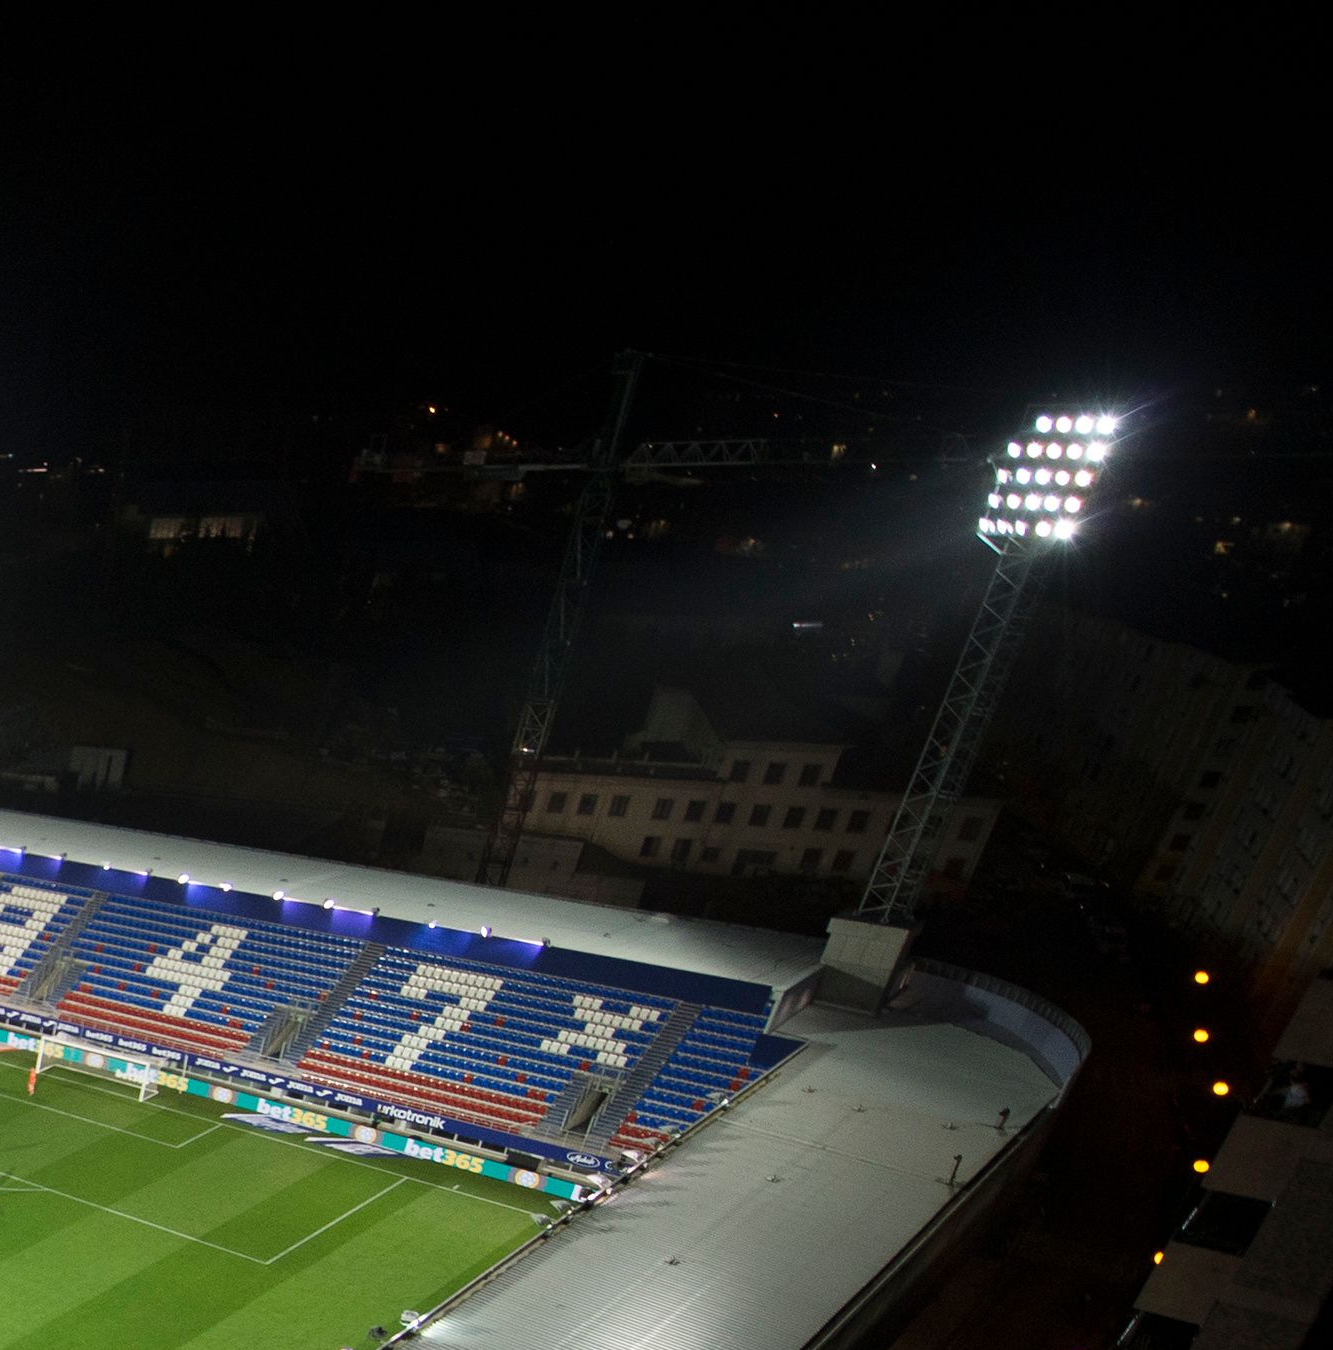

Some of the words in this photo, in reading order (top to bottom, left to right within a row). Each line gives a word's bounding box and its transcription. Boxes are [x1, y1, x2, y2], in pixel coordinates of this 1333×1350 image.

[257, 1098, 328, 1132] bet365
[376, 1103, 446, 1131] urkotronik
[405, 1138, 486, 1174] bet365
